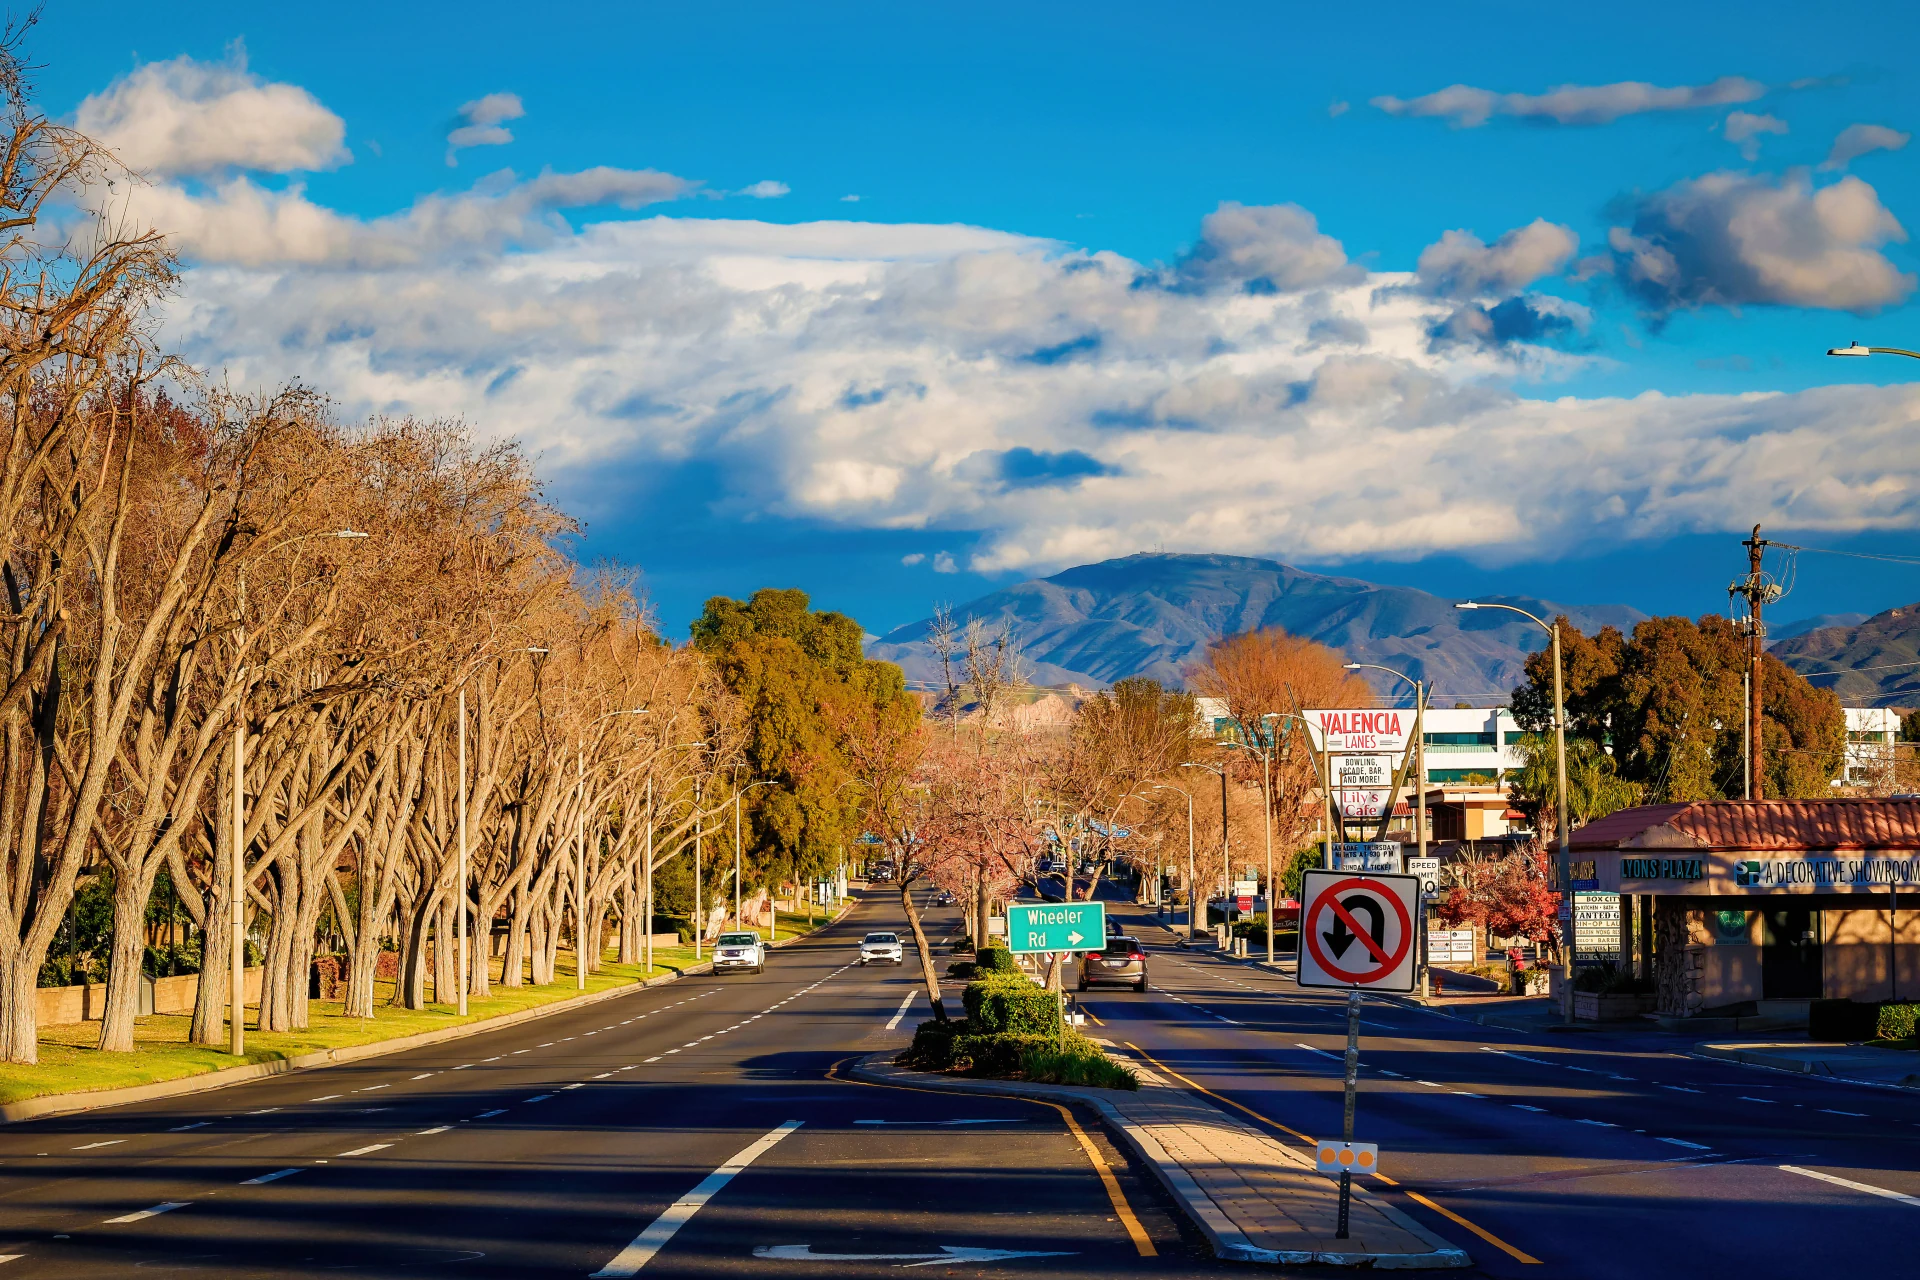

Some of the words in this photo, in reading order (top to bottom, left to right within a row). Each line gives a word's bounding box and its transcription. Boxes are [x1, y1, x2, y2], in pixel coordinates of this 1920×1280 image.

[1320, 713, 1402, 736] VALENCIA
[1345, 735, 1376, 748] LANES
[1345, 758, 1377, 767] BOWLING,
[1339, 767, 1366, 775] ARCADE,
[1343, 792, 1379, 806] Lily's
[1345, 805, 1377, 817] Cafe
[1621, 859, 1656, 879] LYONS
[1661, 859, 1701, 879] PLAZA
[1766, 861, 1774, 884] A
[1777, 861, 1846, 883] DECORATIVE
[1849, 860, 1920, 883] SHOWROOM
[1027, 909, 1083, 925] Wheeler
[1028, 932, 1046, 947] Rd
